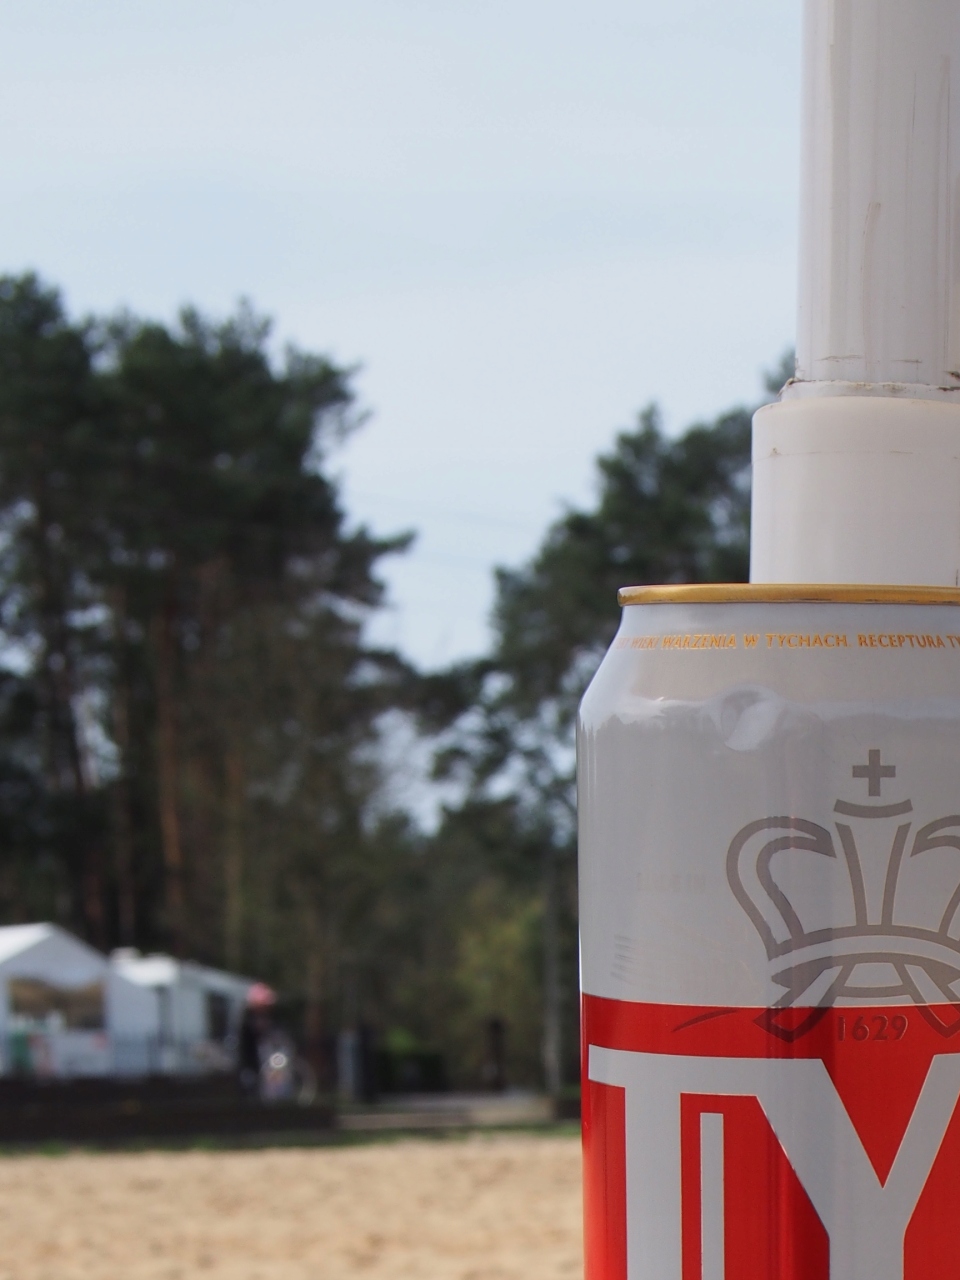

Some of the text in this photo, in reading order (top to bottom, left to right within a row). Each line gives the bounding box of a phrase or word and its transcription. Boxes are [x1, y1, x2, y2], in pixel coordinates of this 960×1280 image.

[661, 634, 737, 649] WARZENIA
[743, 634, 760, 648] W
[857, 633, 945, 649] RECEPTURA
[835, 1014, 909, 1042] 1629
